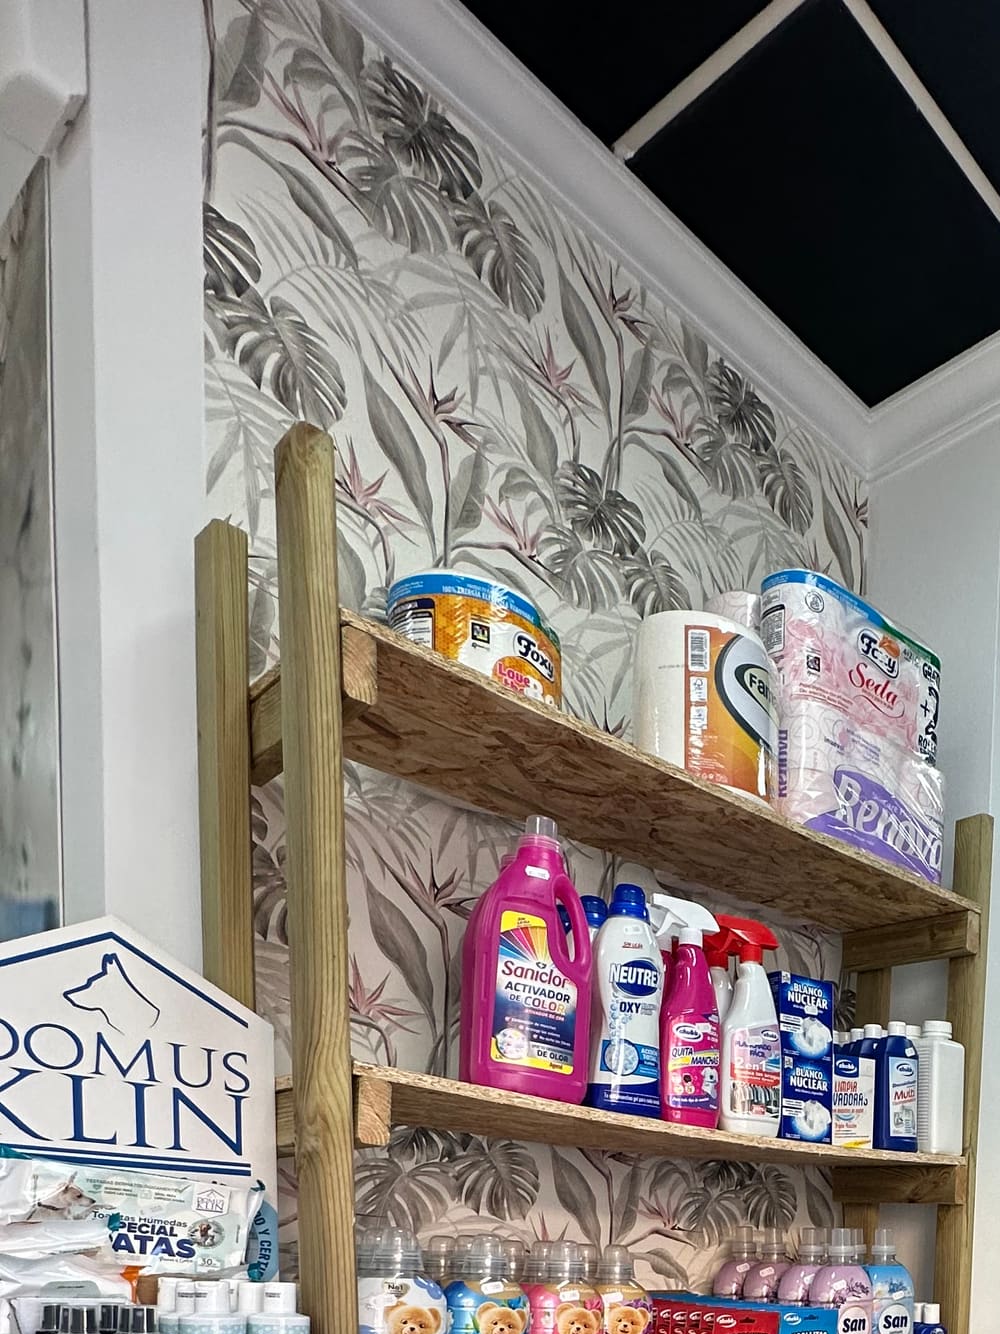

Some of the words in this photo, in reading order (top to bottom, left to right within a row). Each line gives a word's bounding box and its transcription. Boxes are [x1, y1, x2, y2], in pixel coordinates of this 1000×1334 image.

[516, 633, 554, 679] Foxy
[498, 663, 531, 687] Love
[848, 661, 898, 706] Seda
[501, 960, 570, 990] Saniclor
[504, 980, 571, 1005] ACTIVADOR
[792, 982, 824, 998] BLANCO
[509, 993, 522, 1003] DE
[524, 994, 567, 1016] COLOR
[619, 1001, 642, 1015] OXY
[787, 990, 829, 1011] NUCLEAR
[536, 1048, 548, 1059] DE
[548, 1051, 570, 1064] OLOR
[671, 1047, 694, 1057] QUITA
[690, 1055, 720, 1066] MANCHAS
[795, 1067, 824, 1081] BLANCO
[789, 1075, 829, 1092] NUCLEAR
[834, 1080, 858, 1093] LIMPIA
[111, 1232, 196, 1258] ATAS
[842, 1318, 866, 1333] San
[883, 1314, 908, 1329] San
